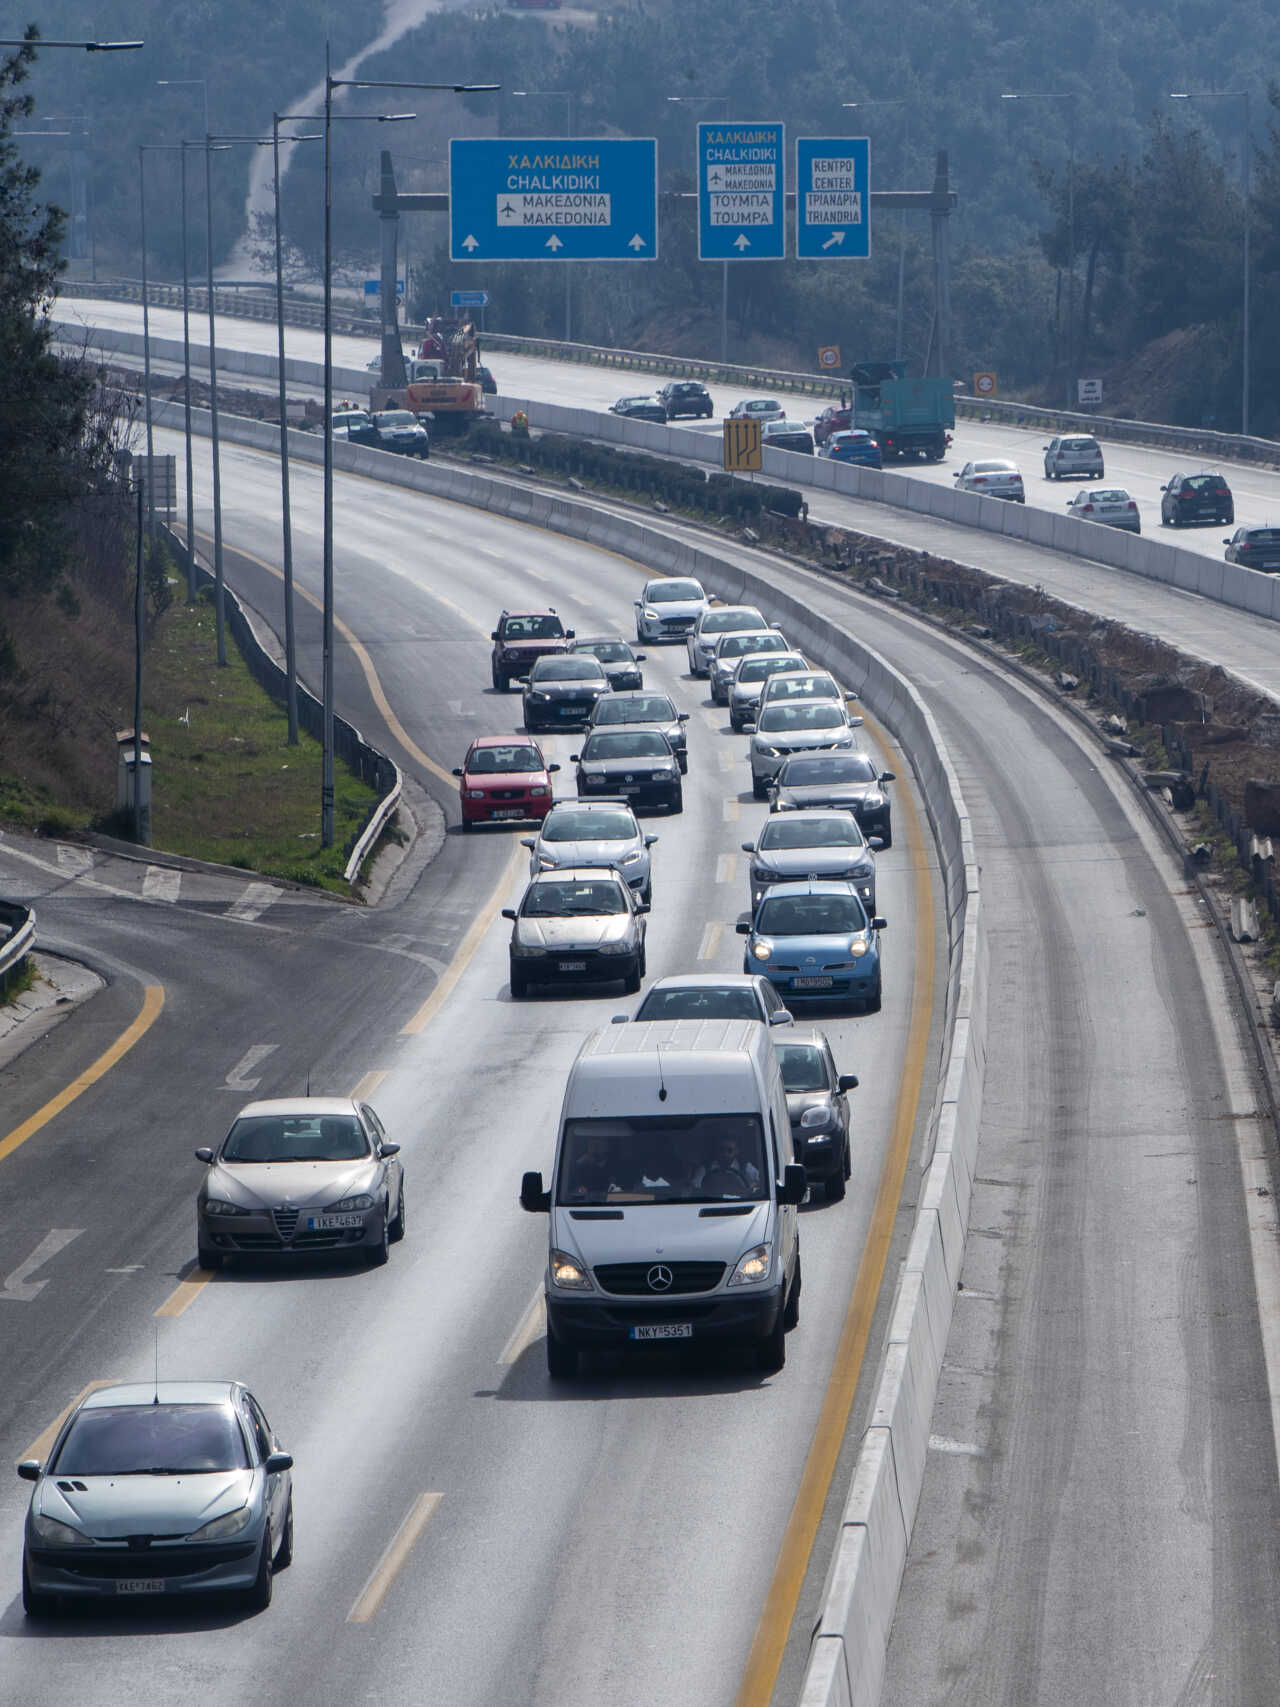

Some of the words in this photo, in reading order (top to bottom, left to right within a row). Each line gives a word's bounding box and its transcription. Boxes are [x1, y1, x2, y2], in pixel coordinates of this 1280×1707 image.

[706, 131, 777, 144] ΧΑΛΚΙΔΙΚΗ
[706, 147, 777, 161] CHALKIDIKI
[508, 154, 600, 169] ΧΑΛΚΙΔΙΚΗ
[814, 160, 852, 173] ΚΕΝΤΡΟ
[725, 165, 773, 176] ΜΑΚΕΔΟΝΙΑ
[507, 174, 600, 190] CHALKIDIKI
[725, 180, 773, 190] MAKEDONIA
[815, 177, 852, 189] CENTER
[523, 195, 607, 207] ΜΑΚΕΔΟΝΙΑ
[714, 195, 770, 207] ΤΟΥΜΠΑ
[808, 194, 858, 206] ΤΡΙΑΝΔΡΙΑ
[523, 212, 608, 224] MAKEDONIA
[714, 212, 769, 224] TOUMPA
[808, 211, 859, 223] TRIANDRIA
